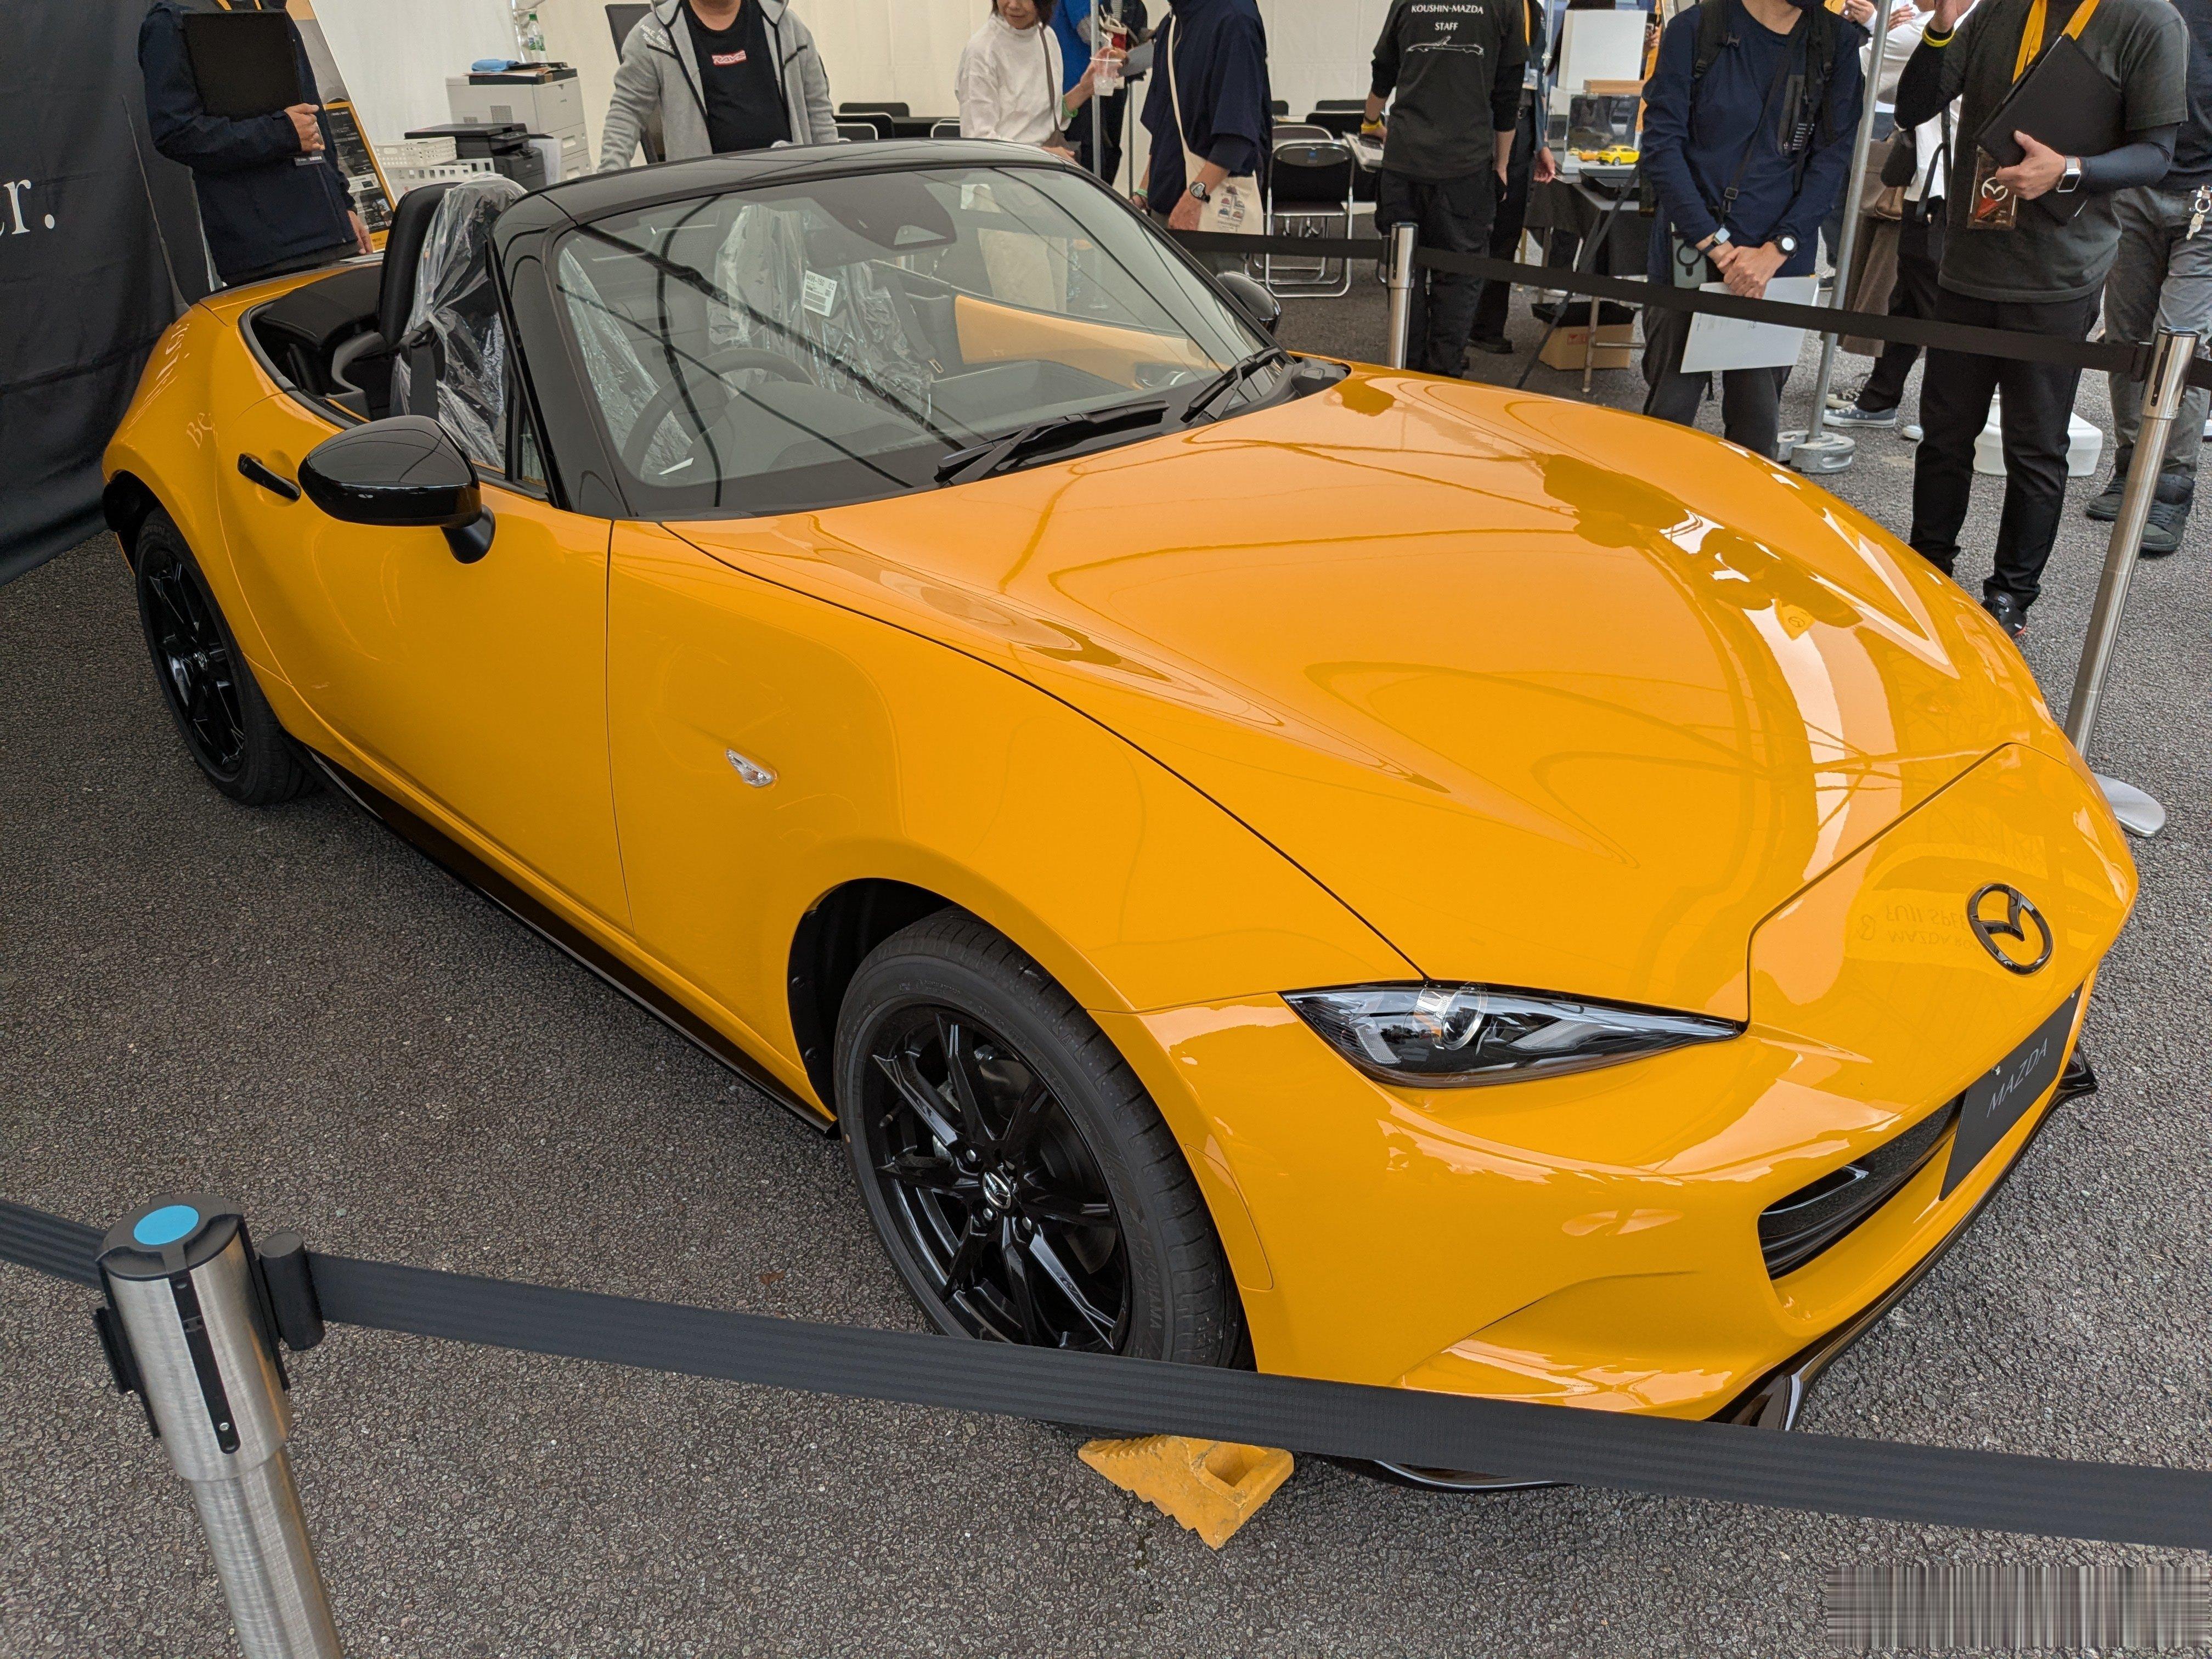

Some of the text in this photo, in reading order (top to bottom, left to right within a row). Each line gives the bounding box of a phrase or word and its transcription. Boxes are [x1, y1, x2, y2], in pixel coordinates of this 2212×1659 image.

[1411, 4, 1484, 14] KOUSHIN-MAZDA
[1435, 22, 1459, 31] STAFF
[1986, 1037, 2048, 1119] MAZDA
